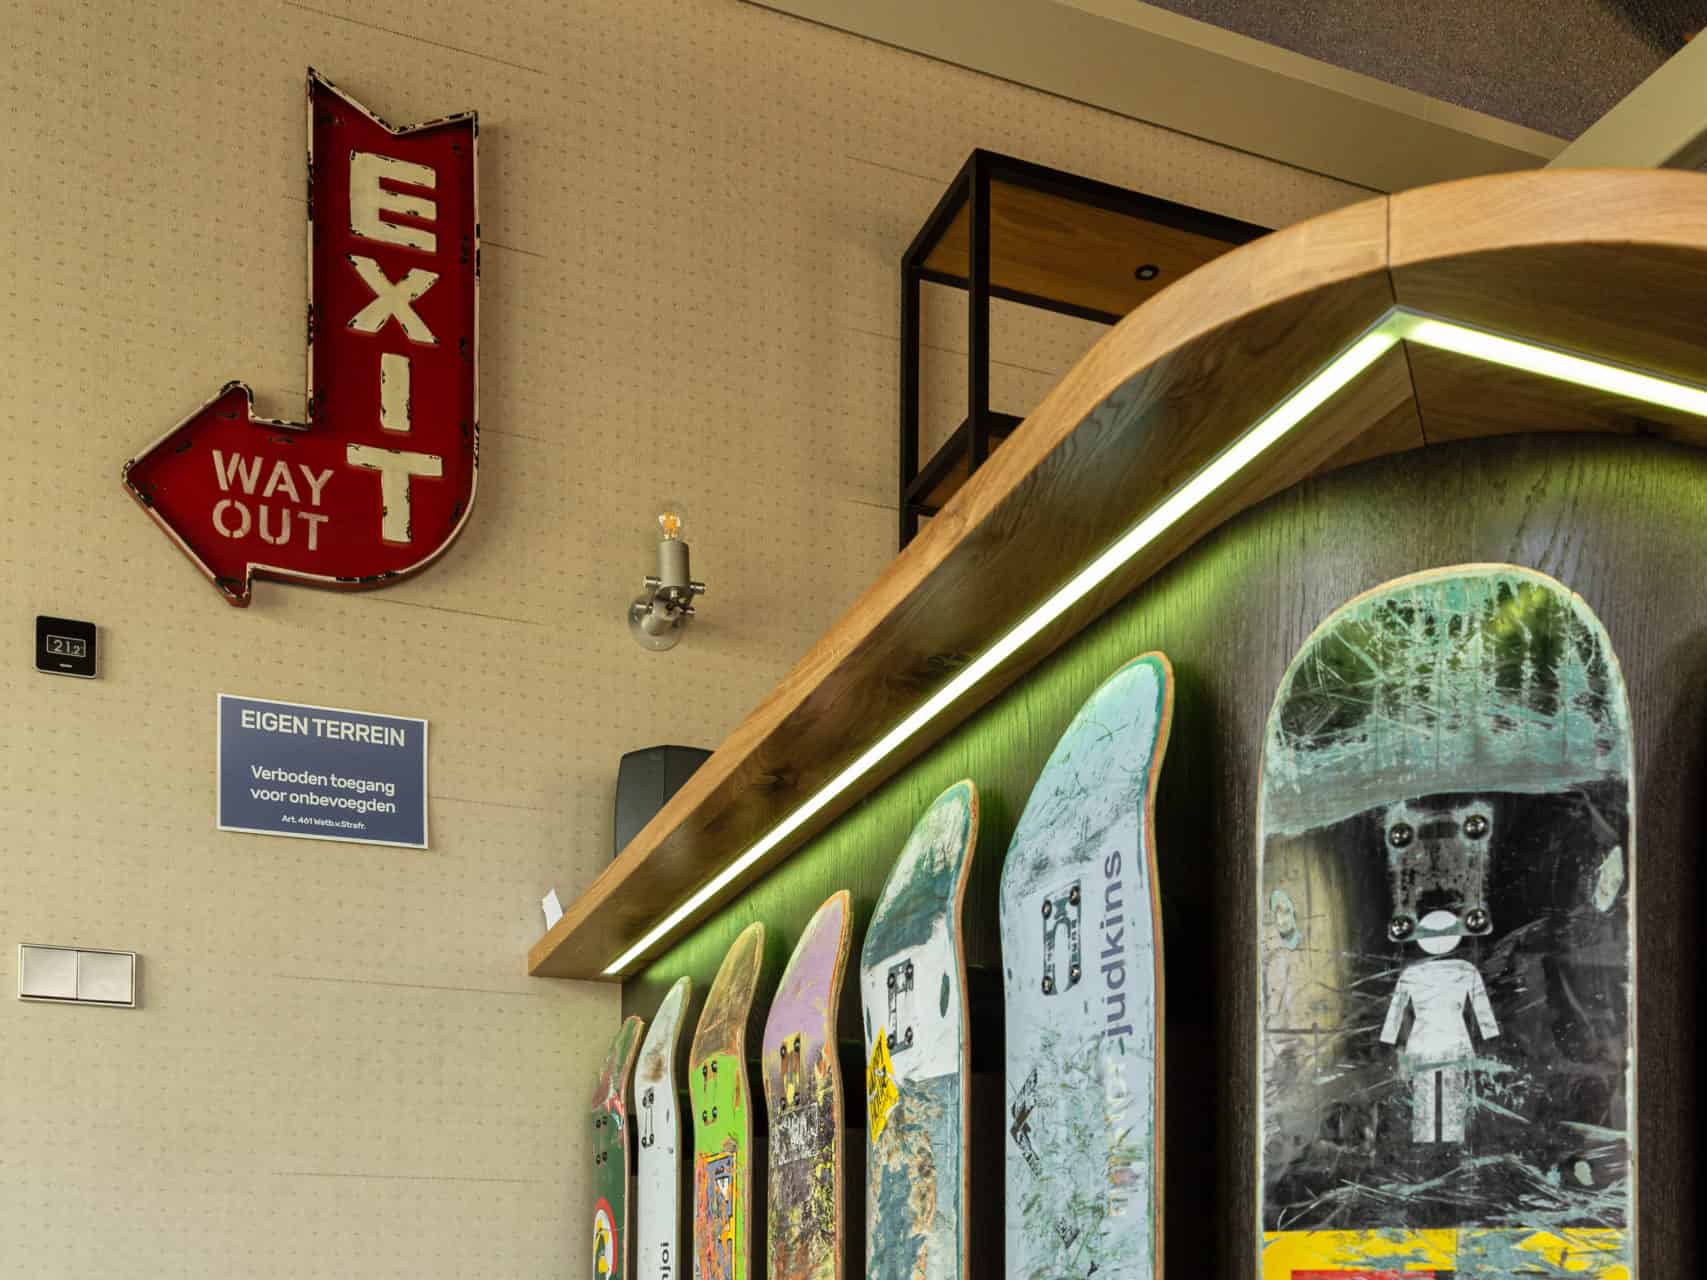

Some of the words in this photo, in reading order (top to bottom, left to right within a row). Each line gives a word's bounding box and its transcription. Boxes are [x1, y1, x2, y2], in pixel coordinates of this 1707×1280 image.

[346, 149, 443, 543] EXIT
[212, 449, 335, 506] WAY
[212, 499, 330, 551] OUT
[241, 709, 308, 735] EIGEN
[312, 718, 405, 746] TERREIN
[250, 787, 287, 801] voor
[289, 792, 396, 813] onbevoegden
[251, 765, 327, 786] Verboden
[330, 774, 395, 797] toegang
[281, 814, 297, 823] Art.
[297, 816, 312, 825] 461
[1099, 849, 1133, 1038] judkins
